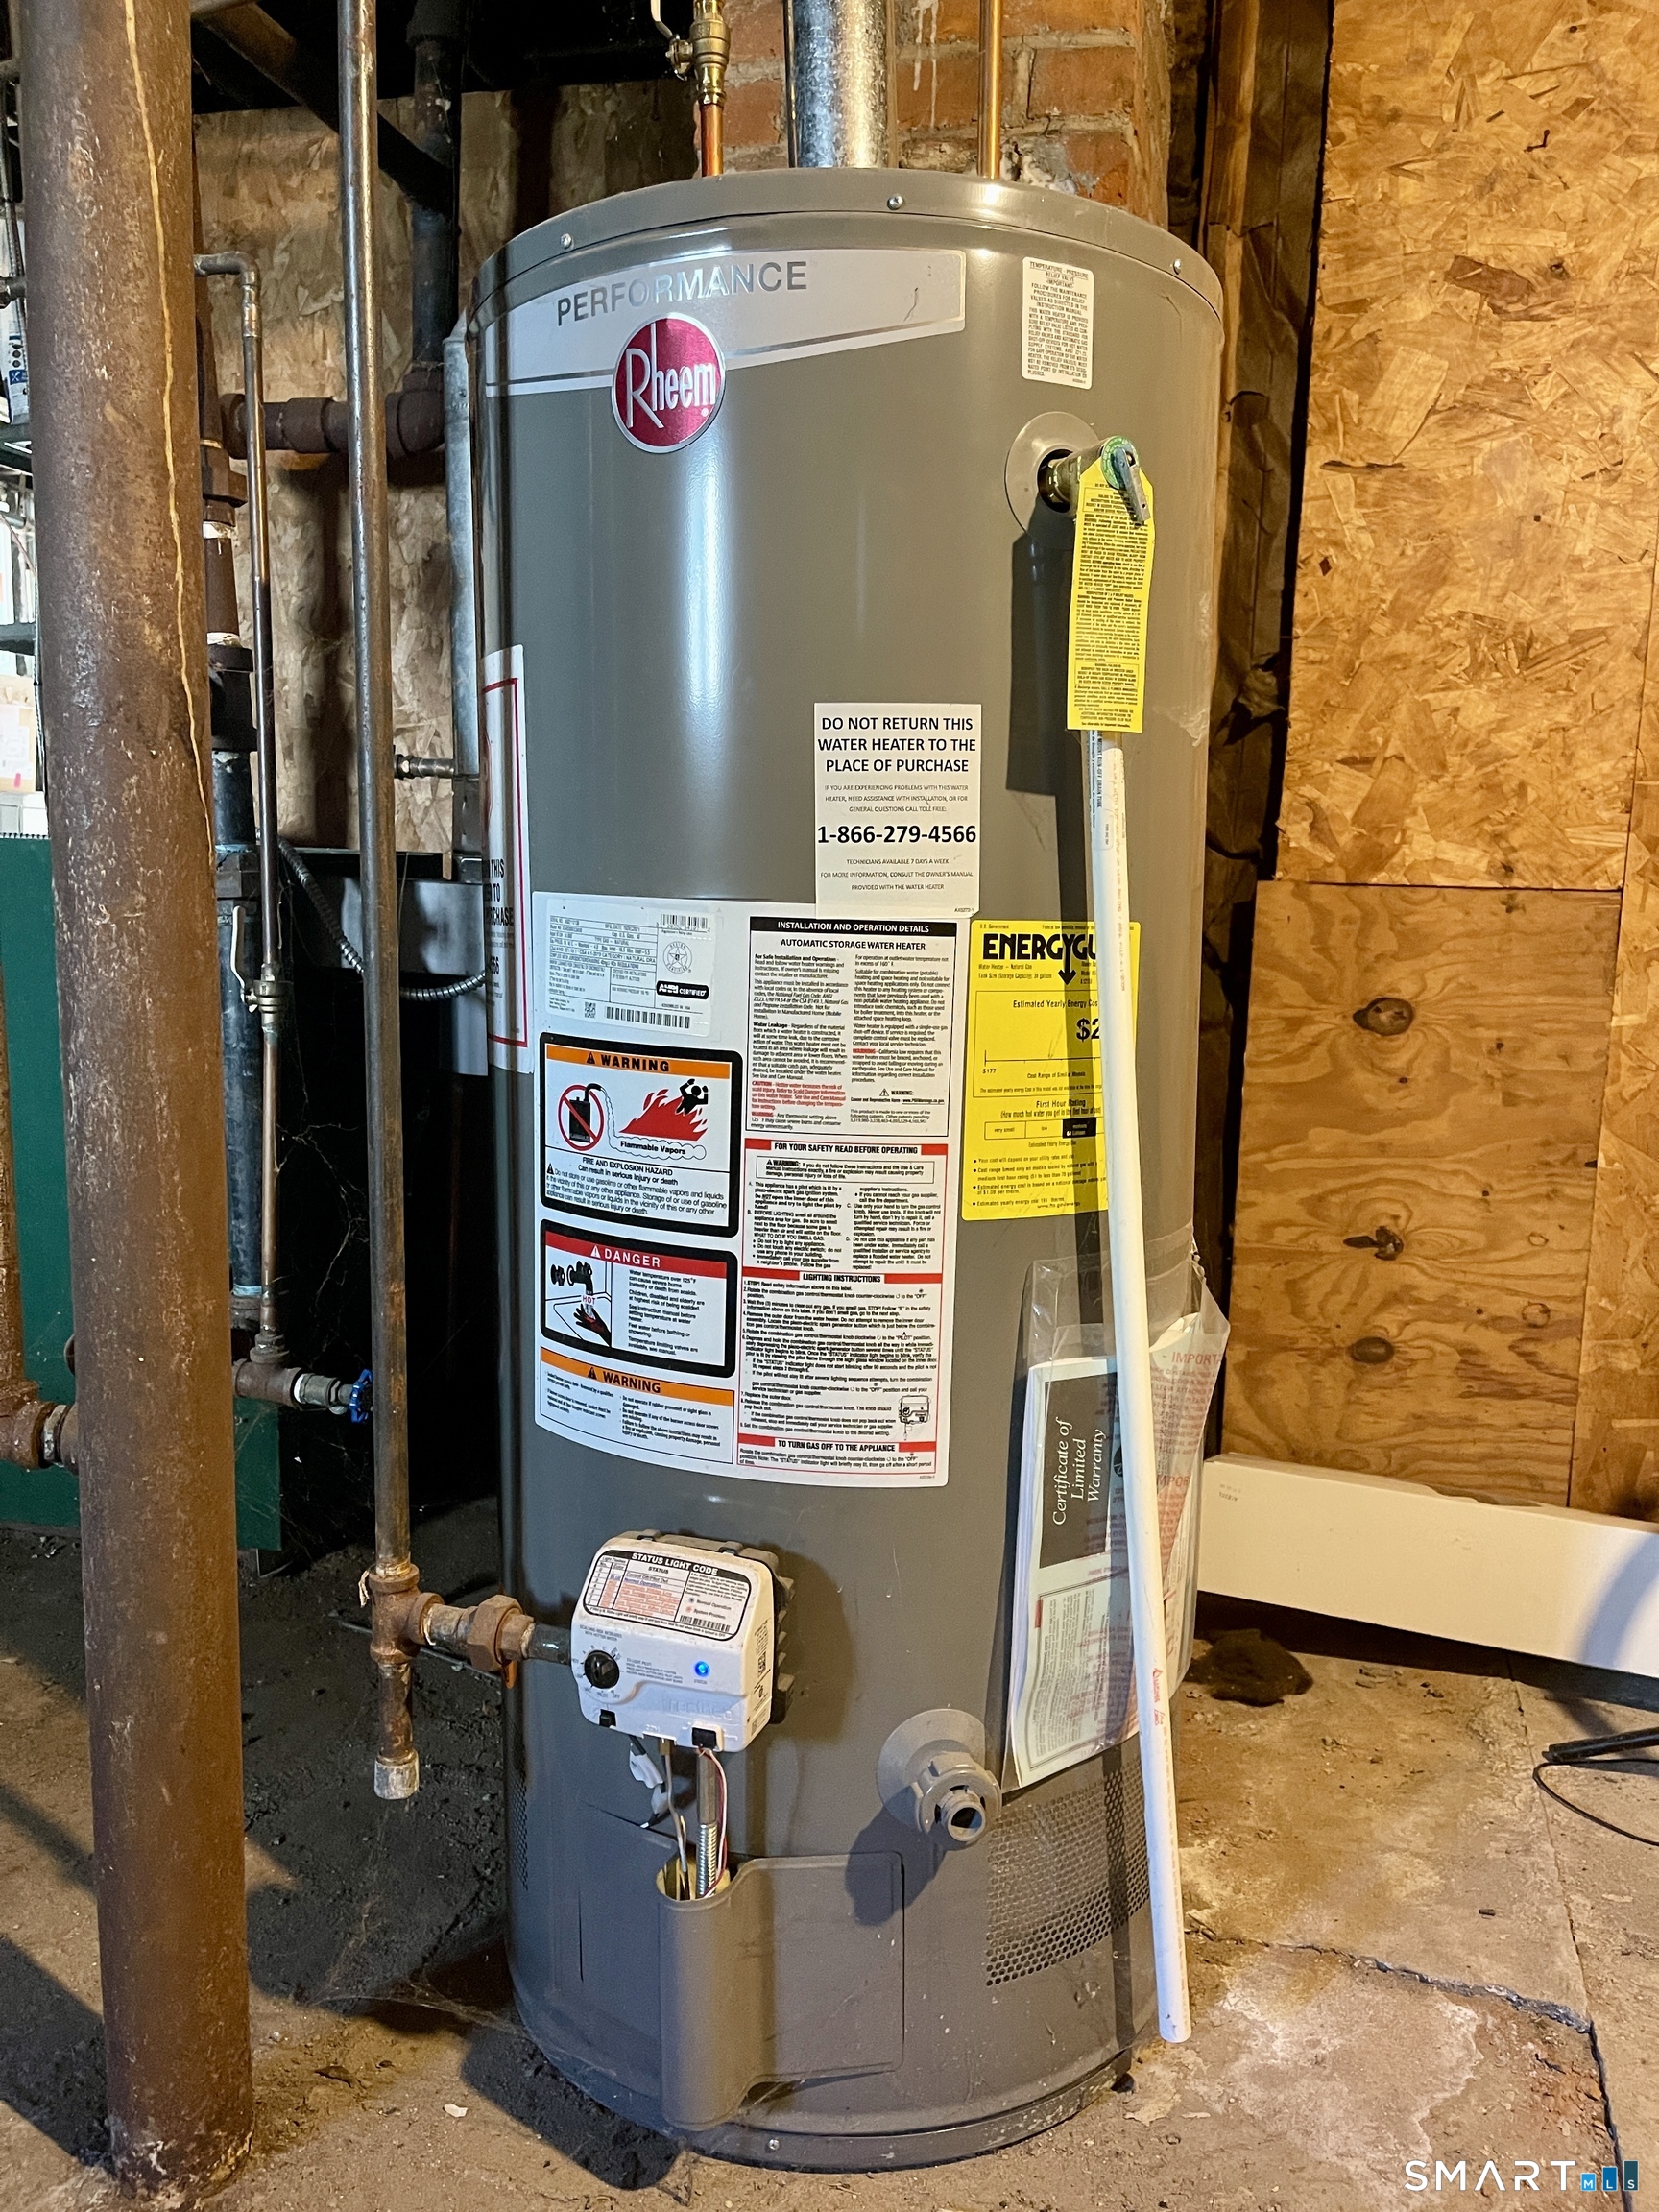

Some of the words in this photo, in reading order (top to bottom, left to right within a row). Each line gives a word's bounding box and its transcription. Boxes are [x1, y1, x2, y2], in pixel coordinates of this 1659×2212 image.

[557, 261, 807, 326] PERFORMANCE
[625, 322, 716, 429] Rheem
[822, 717, 843, 730] DO
[849, 717, 878, 730] NOT
[883, 717, 939, 730] RETURN
[943, 718, 973, 731] THIS
[818, 738, 867, 751] WATER
[872, 738, 925, 751] HEATER
[928, 739, 947, 751] TO
[950, 739, 975, 751] THE
[826, 759, 869, 772] PLACE
[874, 759, 892, 772] OF
[897, 759, 969, 772] PURCHASE
[818, 826, 976, 843] 1-866-279-4566
[492, 858, 504, 878] THIS
[493, 883, 501, 902] TO
[778, 921, 831, 931] INSTALLATION
[833, 923, 852, 931] AND
[854, 923, 898, 932] OPERATION
[899, 925, 929, 933] DETAILS
[781, 939, 828, 949] AUTOMATIC
[830, 940, 866, 949] STORAGE
[867, 941, 895, 950] WATER
[983, 933, 1096, 960] ENERGYGU
[601, 1054, 669, 1072] WARNING
[620, 1141, 658, 1151] Flammable
[661, 1145, 685, 1154] Vapors
[775, 1142, 787, 1151] FOR
[789, 1143, 806, 1152] YOUR
[808, 1144, 833, 1153] SAFETY
[854, 1145, 880, 1154] BEFORE
[596, 1159, 608, 1167] AND
[610, 1162, 643, 1172] EXPLOSION
[645, 1166, 673, 1176] HAZARD
[612, 1170, 632, 1179] serious
[596, 1178, 616, 1188] gasoline
[639, 1185, 667, 1193] flammable
[605, 1248, 661, 1267] DANGER
[803, 1273, 832, 1283] LIGHTING
[834, 1274, 880, 1283] INSTRUCTIONS
[583, 1296, 595, 1305] HOT
[1171, 1352, 1222, 1365] IMPORT
[603, 1371, 661, 1393] WARNING
[1056, 1416, 1073, 1436] of
[787, 1441, 805, 1450] TURN
[1071, 1438, 1086, 1500] Limited
[1088, 1429, 1106, 1502] Warranty
[1052, 1441, 1070, 1526] Certificate
[632, 1553, 663, 1565] STATUS
[665, 1557, 690, 1569] LIGHT
[693, 1563, 718, 1575] CODE
[648, 1566, 669, 1575] STATUS
